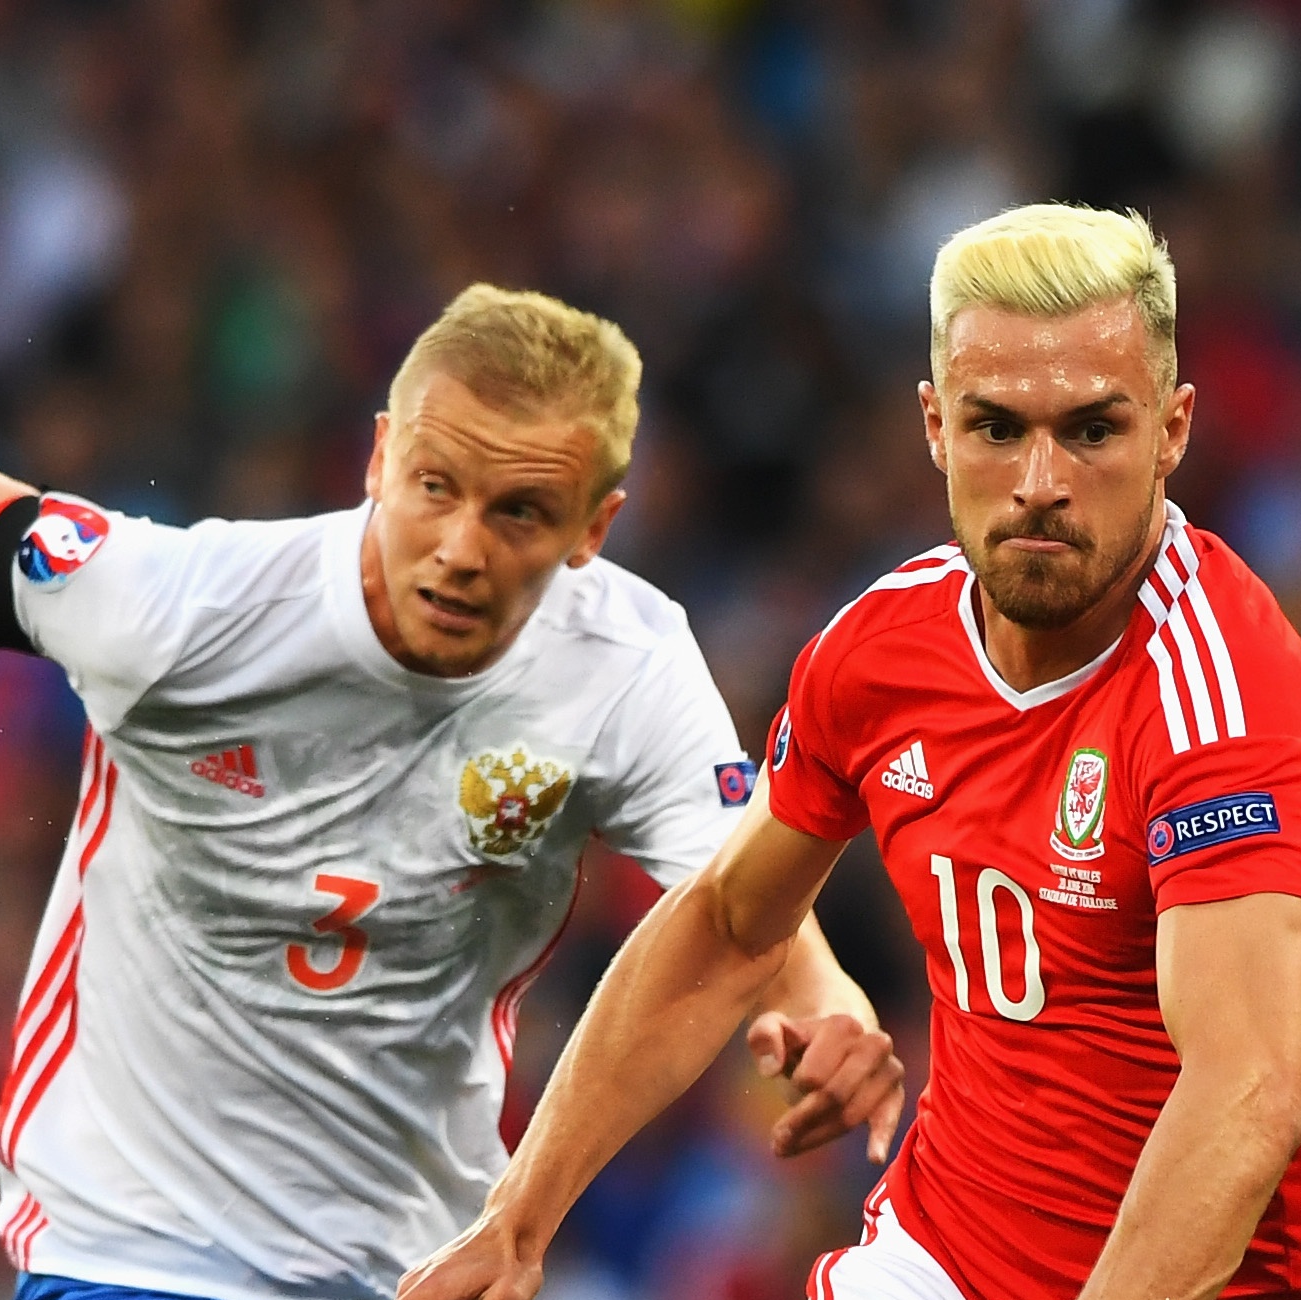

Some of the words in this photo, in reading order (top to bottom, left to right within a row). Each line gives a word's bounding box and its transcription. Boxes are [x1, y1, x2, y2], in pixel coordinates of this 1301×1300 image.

[190, 762, 265, 798] adidas
[881, 771, 934, 799] adidas
[1175, 803, 1274, 841] RESPECT
[286, 872, 380, 992] 3
[930, 853, 1046, 1022] 10
